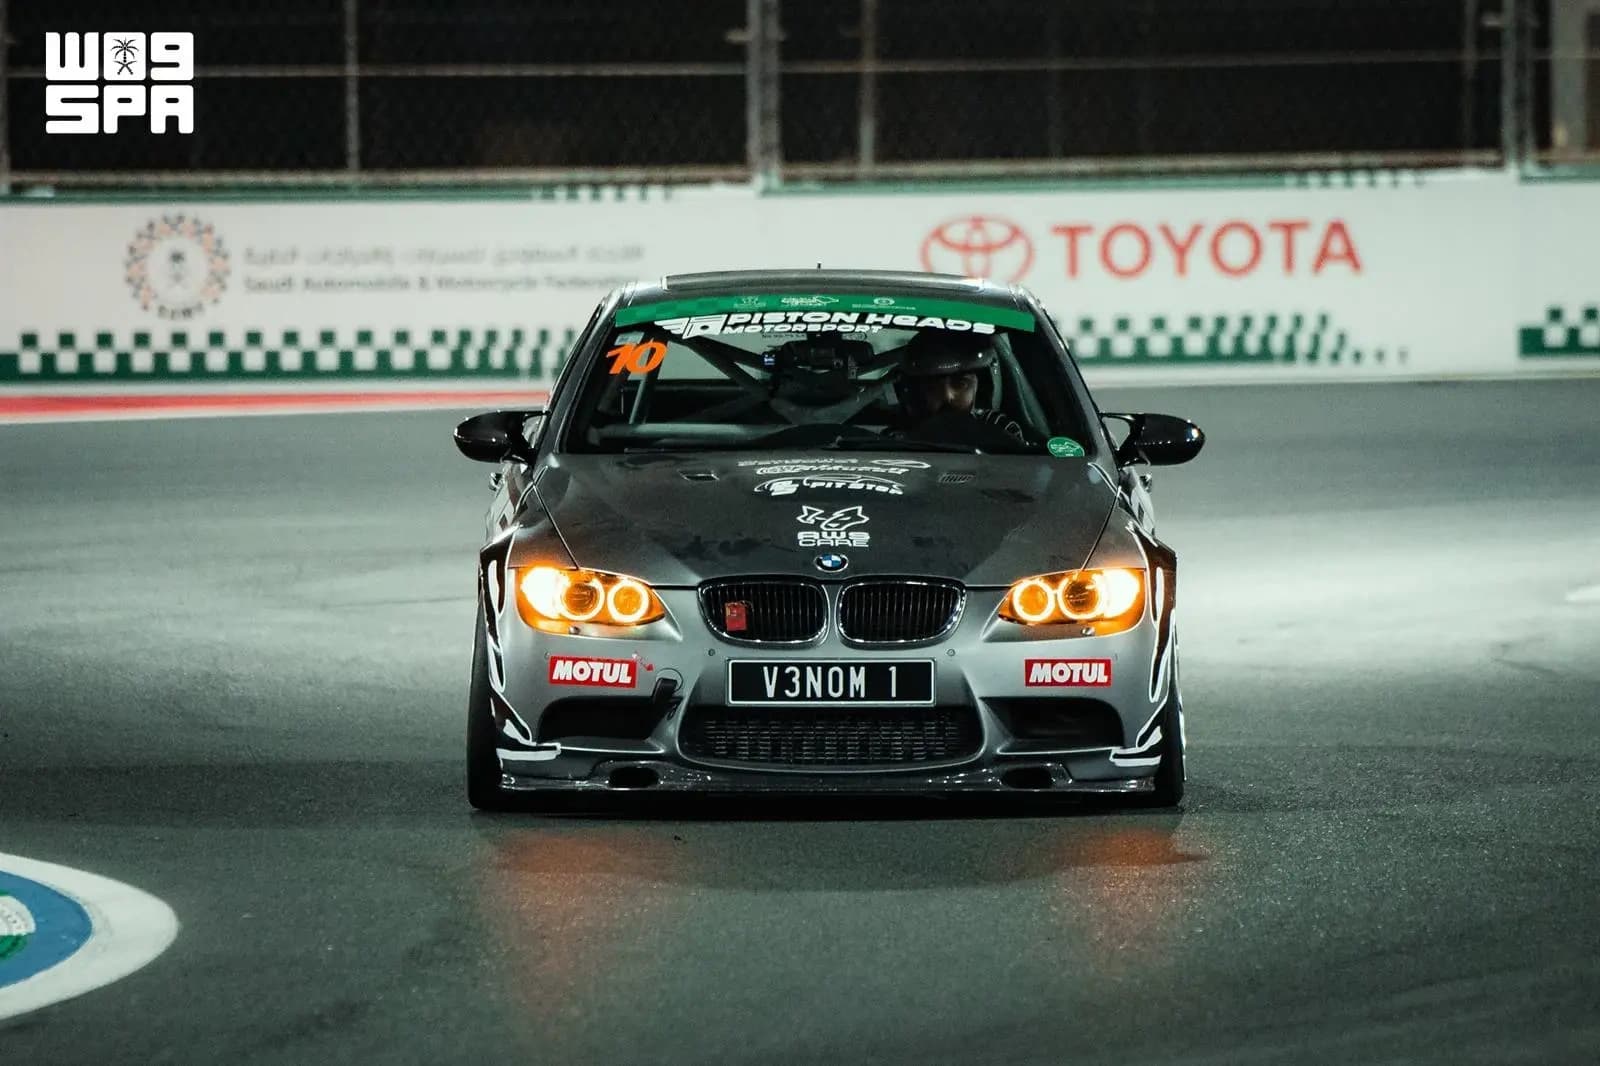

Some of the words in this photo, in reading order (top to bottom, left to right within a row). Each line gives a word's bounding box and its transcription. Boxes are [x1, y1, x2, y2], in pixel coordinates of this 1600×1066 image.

[1052, 219, 1364, 278] TOYOTA
[722, 323, 884, 335] MOTORSPORT
[727, 311, 861, 325] PISTON
[606, 341, 667, 375] 10
[798, 539, 869, 548] CARE
[552, 659, 633, 684] MOTUL
[888, 666, 897, 698] 1
[1029, 662, 1109, 684] MOTUL
